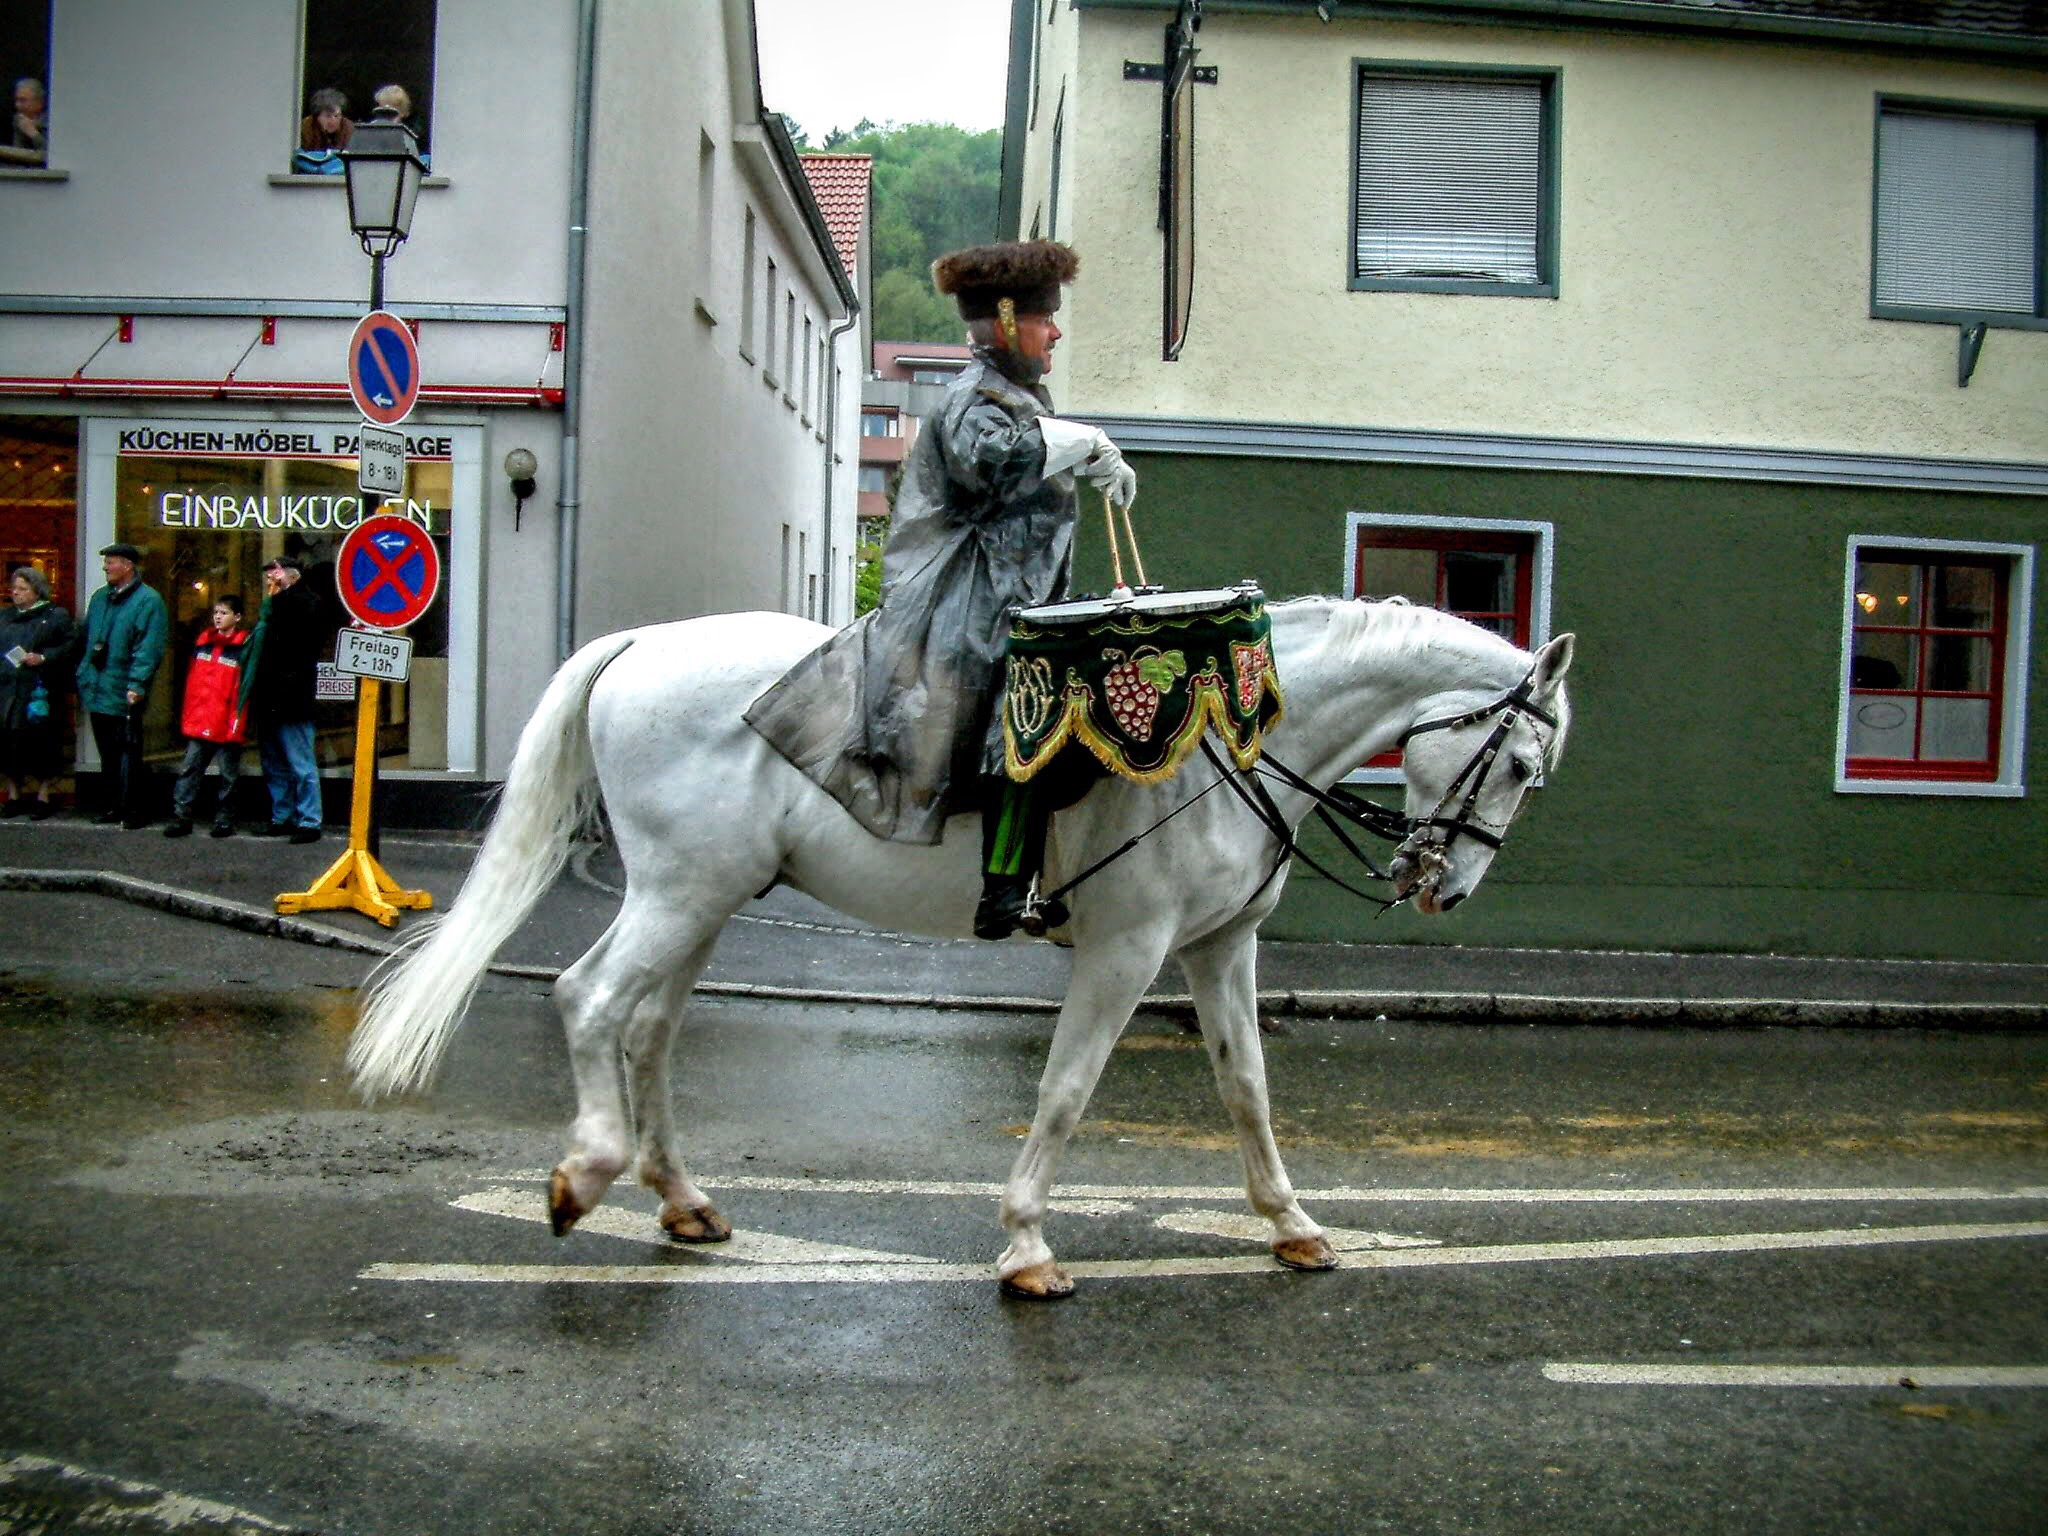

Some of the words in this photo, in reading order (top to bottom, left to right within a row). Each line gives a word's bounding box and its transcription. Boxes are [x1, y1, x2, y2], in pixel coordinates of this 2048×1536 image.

[119, 427, 321, 453] KÜCHEN-MÖBEL
[333, 434, 452, 456] PAAGE
[364, 438, 402, 458] werktags
[350, 636, 399, 659] Freitag
[319, 681, 355, 693] PREISE
